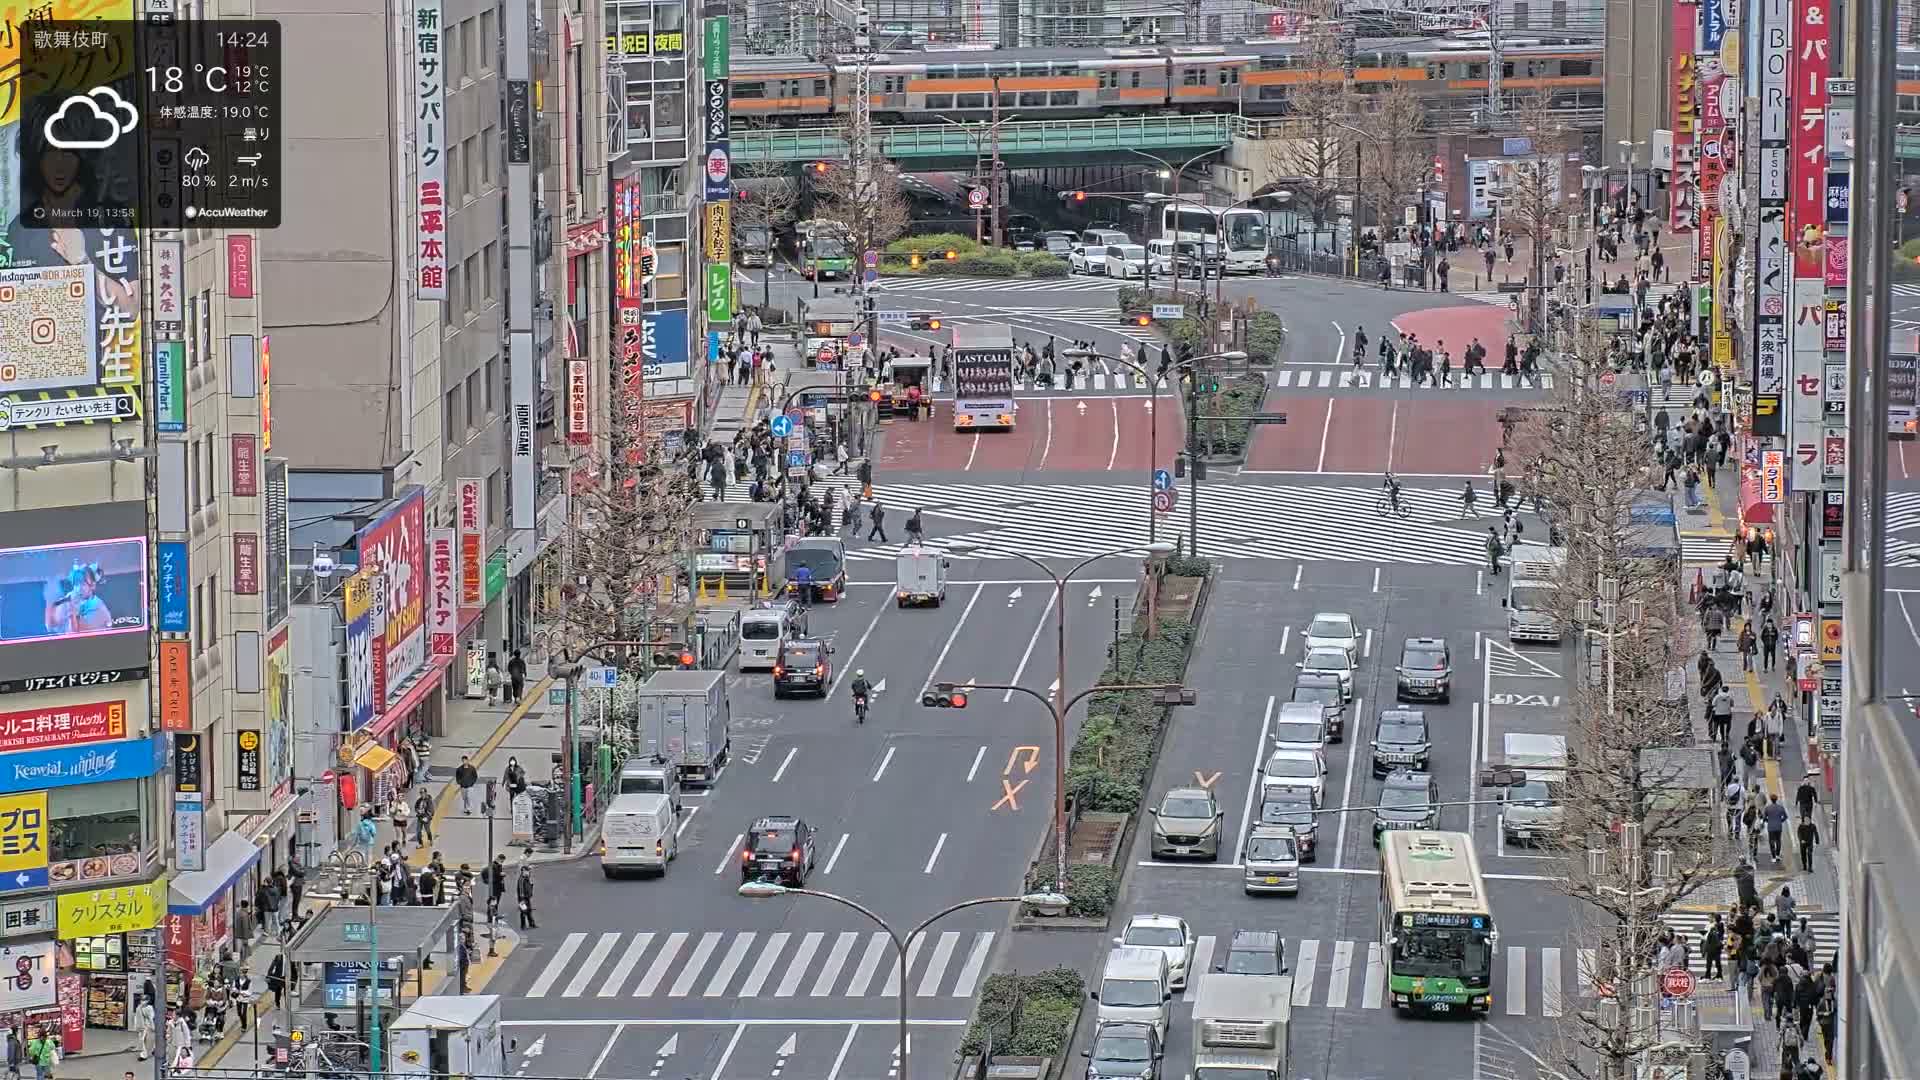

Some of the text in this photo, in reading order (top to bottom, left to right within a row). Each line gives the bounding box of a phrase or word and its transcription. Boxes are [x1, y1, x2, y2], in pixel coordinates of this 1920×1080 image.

[623, 34, 647, 52] 祝日
[654, 32, 682, 51] 夜間
[1707, 85, 1720, 117] アコム
[417, 9, 443, 288] 新宿サンパーク 三平本館
[710, 158, 726, 174] 薬
[711, 205, 726, 260] 肉汁水餃子
[711, 272, 725, 311] レイク
[160, 321, 176, 330] 3F
[1761, 327, 1775, 379] 大衆酒場
[158, 351, 170, 411] FamilyMart
[1797, 305, 1823, 465] パセラ
[15, 402, 114, 417] テンクリ たいせい先生
[1830, 402, 1844, 412] 5F
[515, 404, 530, 457] HOMEGAME
[463, 484, 474, 528] GAME
[434, 539, 451, 626] 三平ストア
[375, 577, 384, 617] 389
[25, 671, 121, 691] リアエイドビジョン
[111, 709, 120, 732] 5F
[26, 732, 71, 744] RESTAURANT
[2, 808, 40, 832] プロ
[2, 833, 40, 855] ミス
[5, 908, 40, 929] 囲碁
[72, 900, 143, 924] クリスタル
[328, 988, 344, 1001] 12
